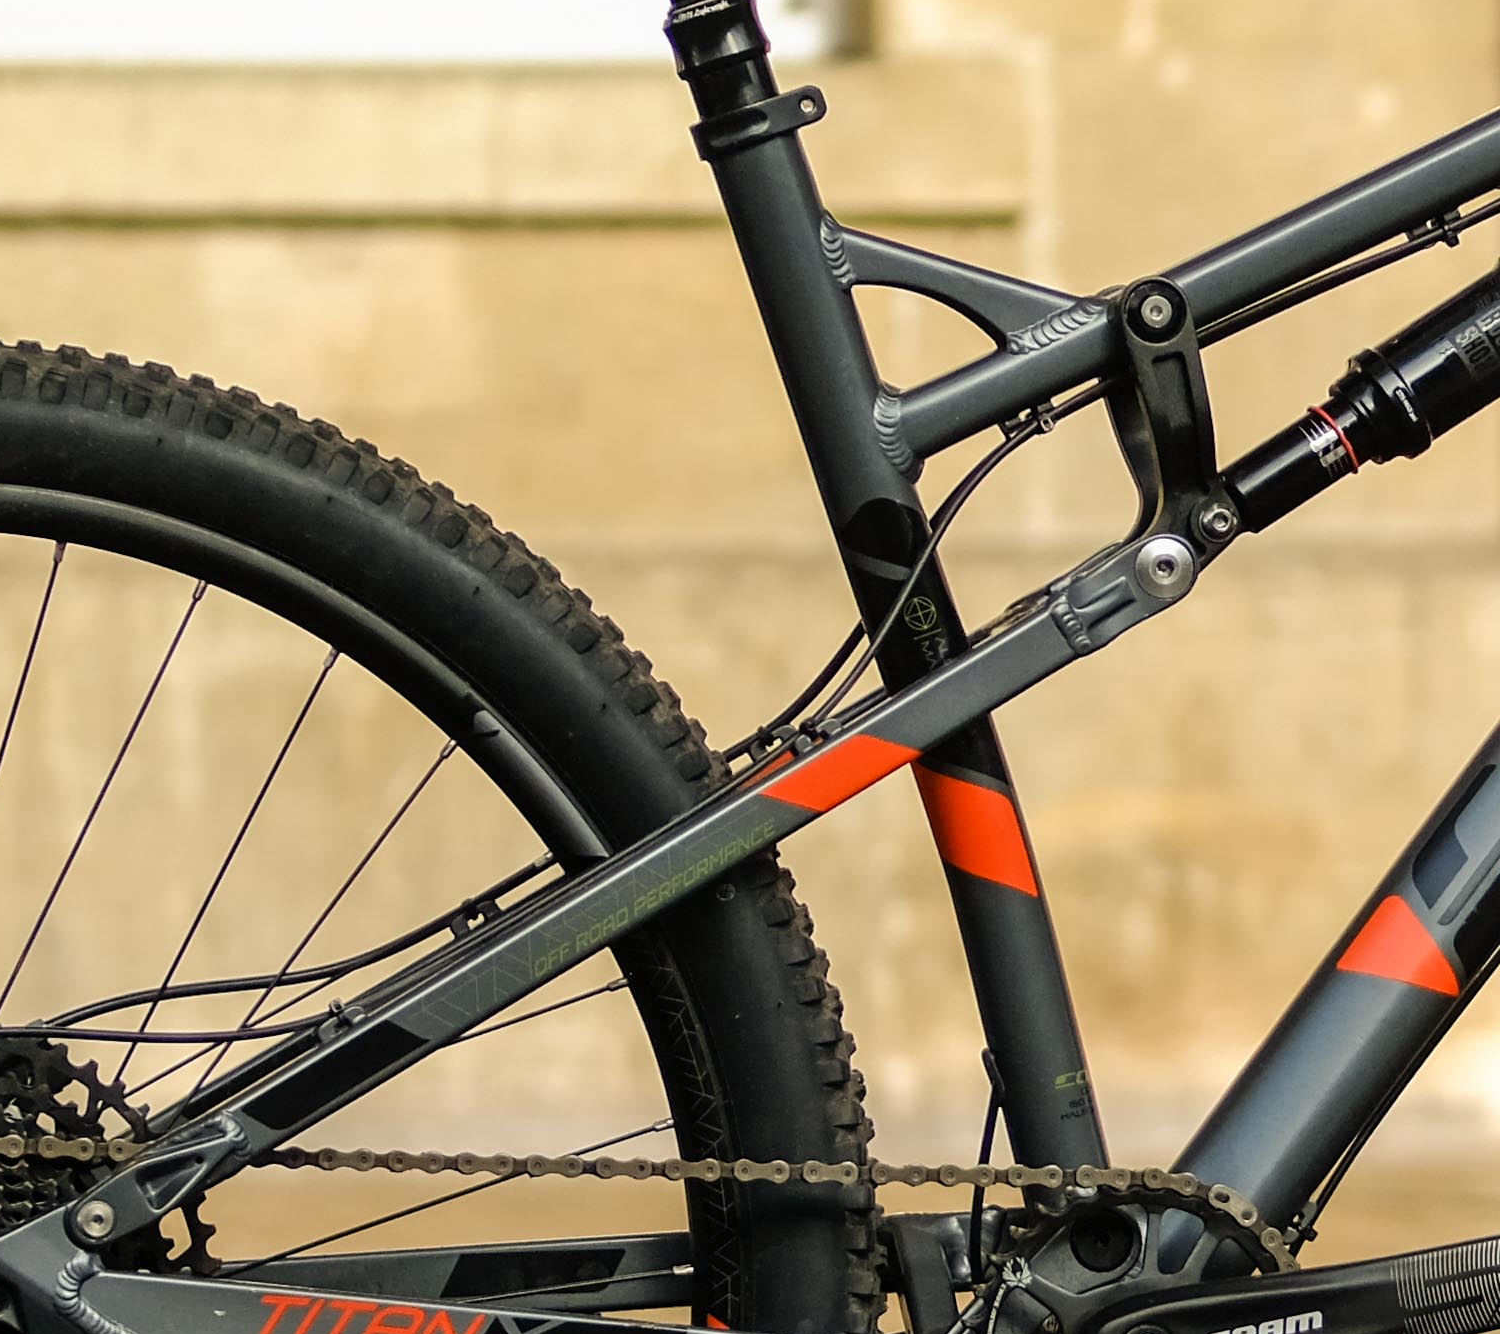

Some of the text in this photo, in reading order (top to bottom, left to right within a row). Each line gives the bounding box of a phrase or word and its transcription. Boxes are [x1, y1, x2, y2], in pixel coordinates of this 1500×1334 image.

[532, 818, 777, 978] OFF ROAD PERFORMANCE
